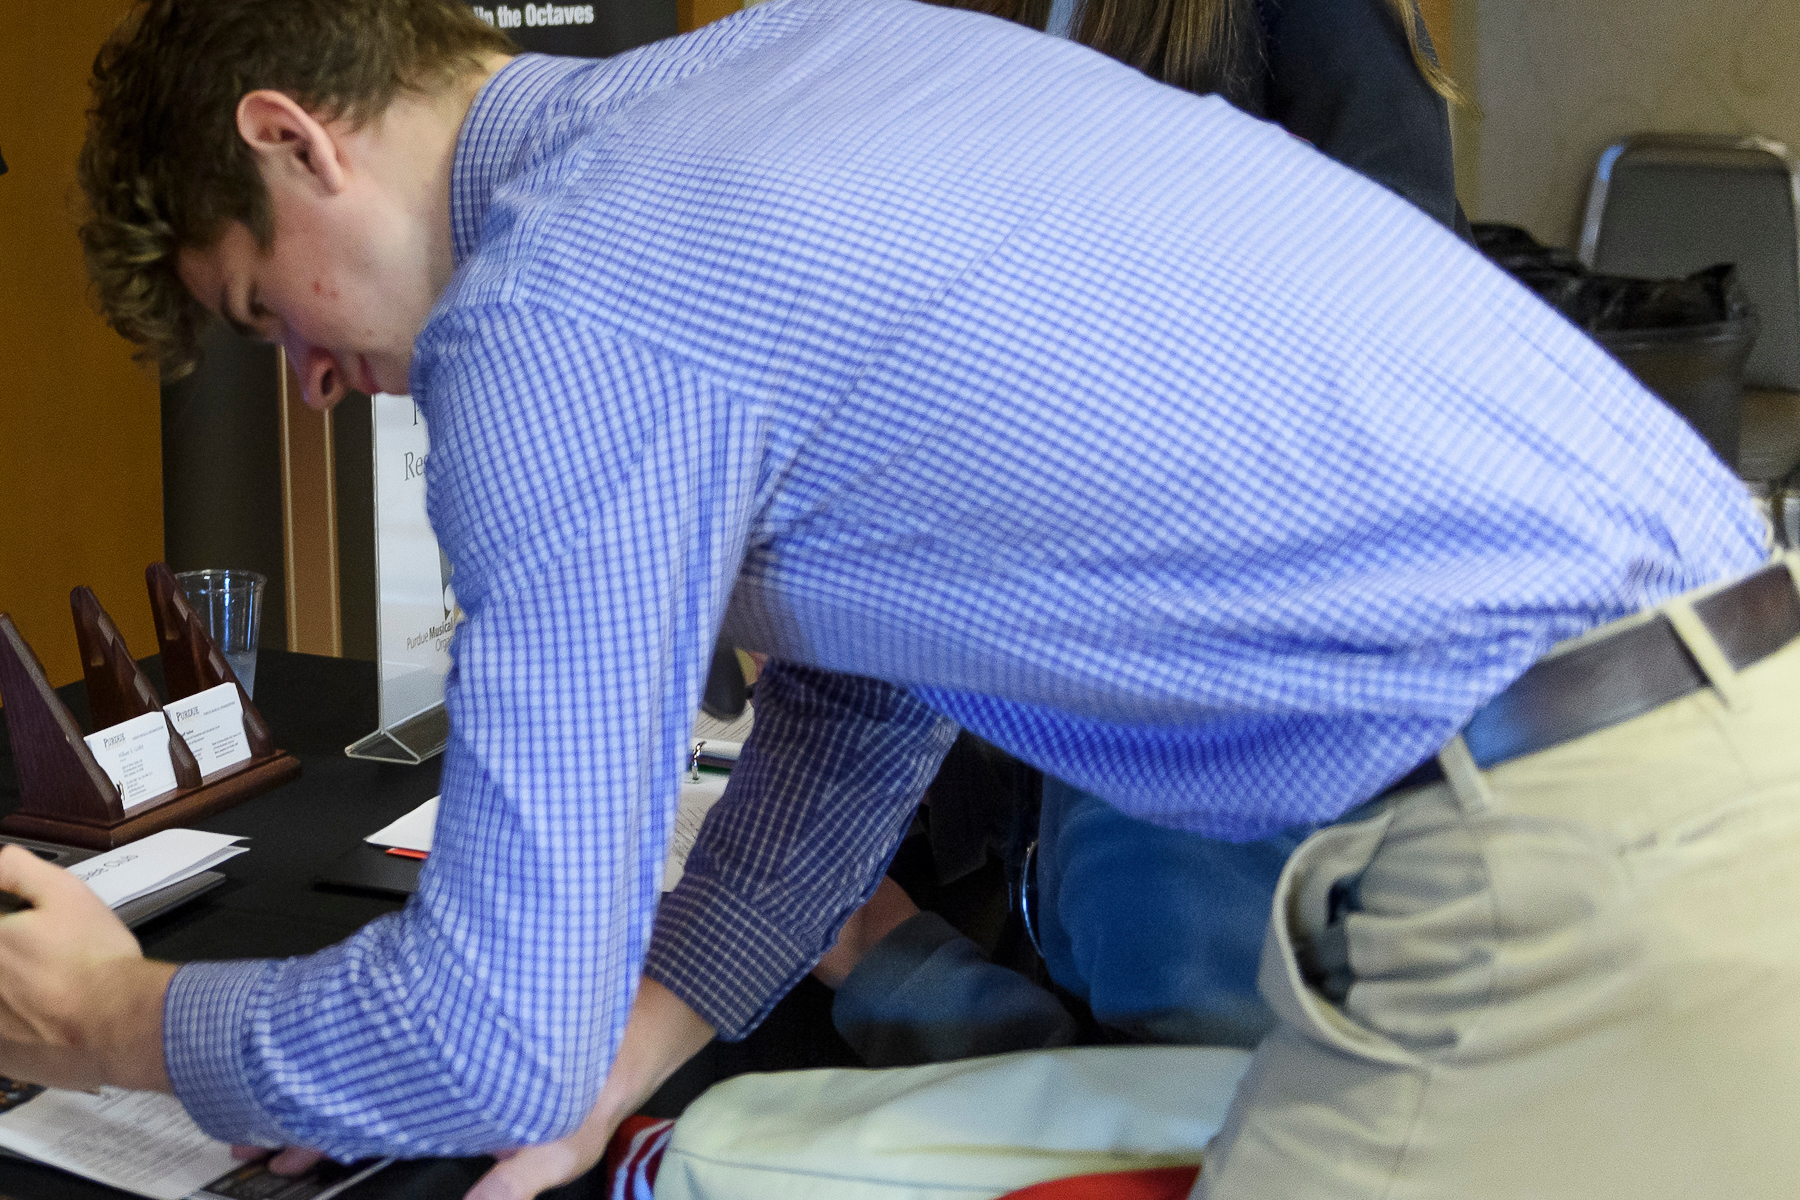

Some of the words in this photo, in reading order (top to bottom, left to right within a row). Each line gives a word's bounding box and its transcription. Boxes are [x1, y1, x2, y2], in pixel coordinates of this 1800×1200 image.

[496, 4, 522, 29] the
[525, 2, 595, 27] Octaves
[406, 632, 429, 651] Purdue
[429, 616, 453, 641] Musical
